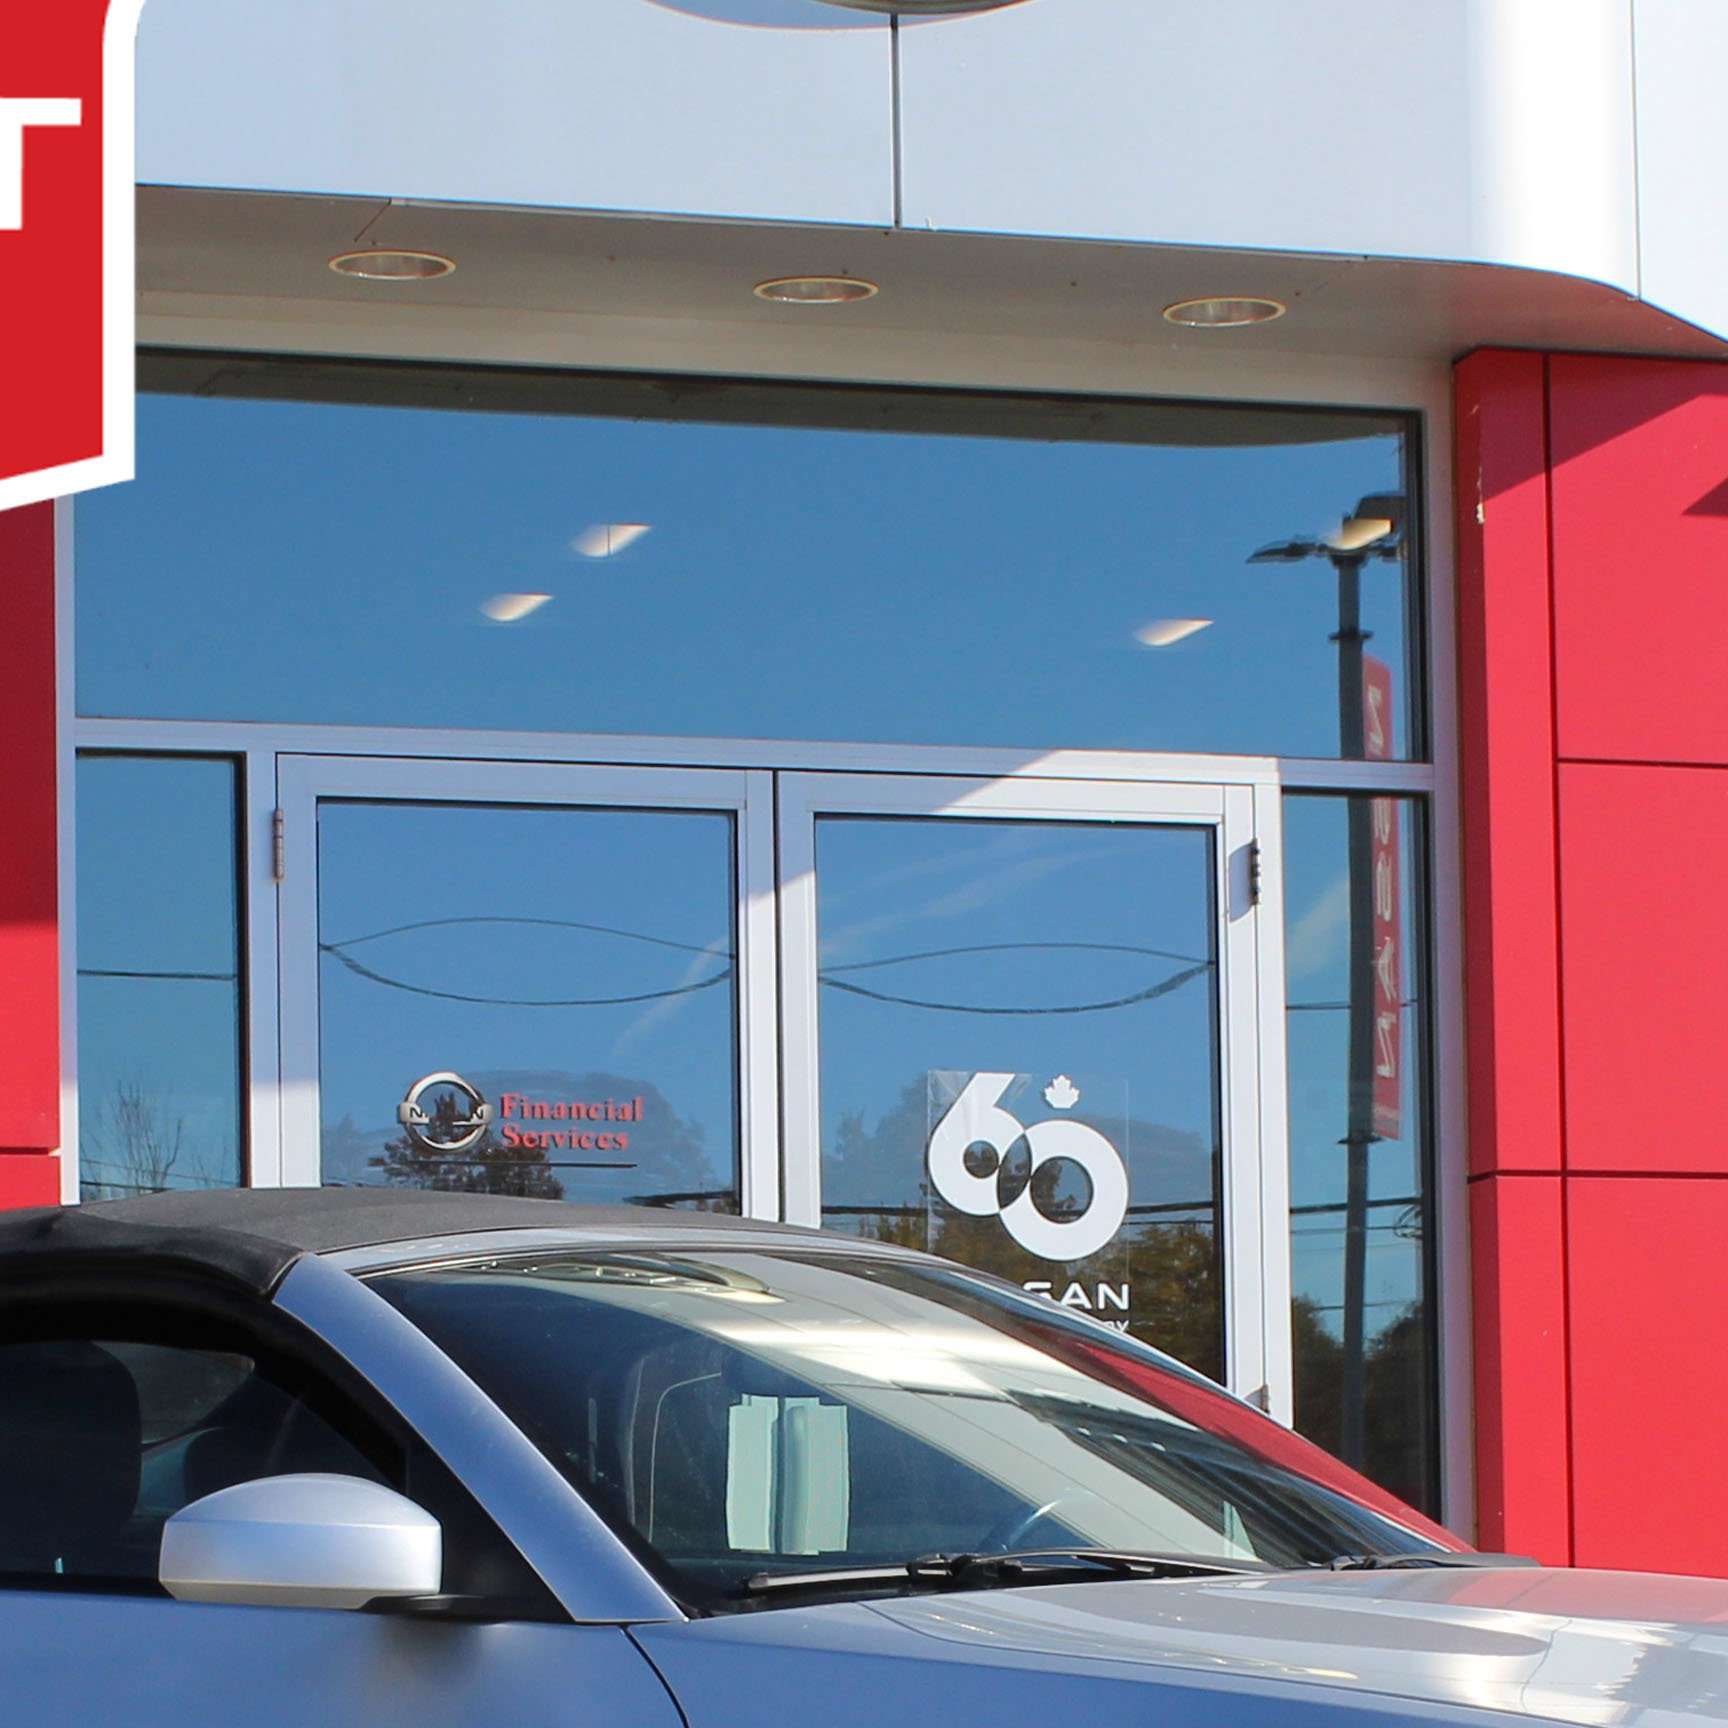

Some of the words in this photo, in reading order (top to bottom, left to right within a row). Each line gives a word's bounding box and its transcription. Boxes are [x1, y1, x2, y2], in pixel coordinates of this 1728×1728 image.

[500, 1092, 644, 1122] Financial
[501, 1123, 629, 1151] Services
[927, 1072, 1128, 1261] 60
